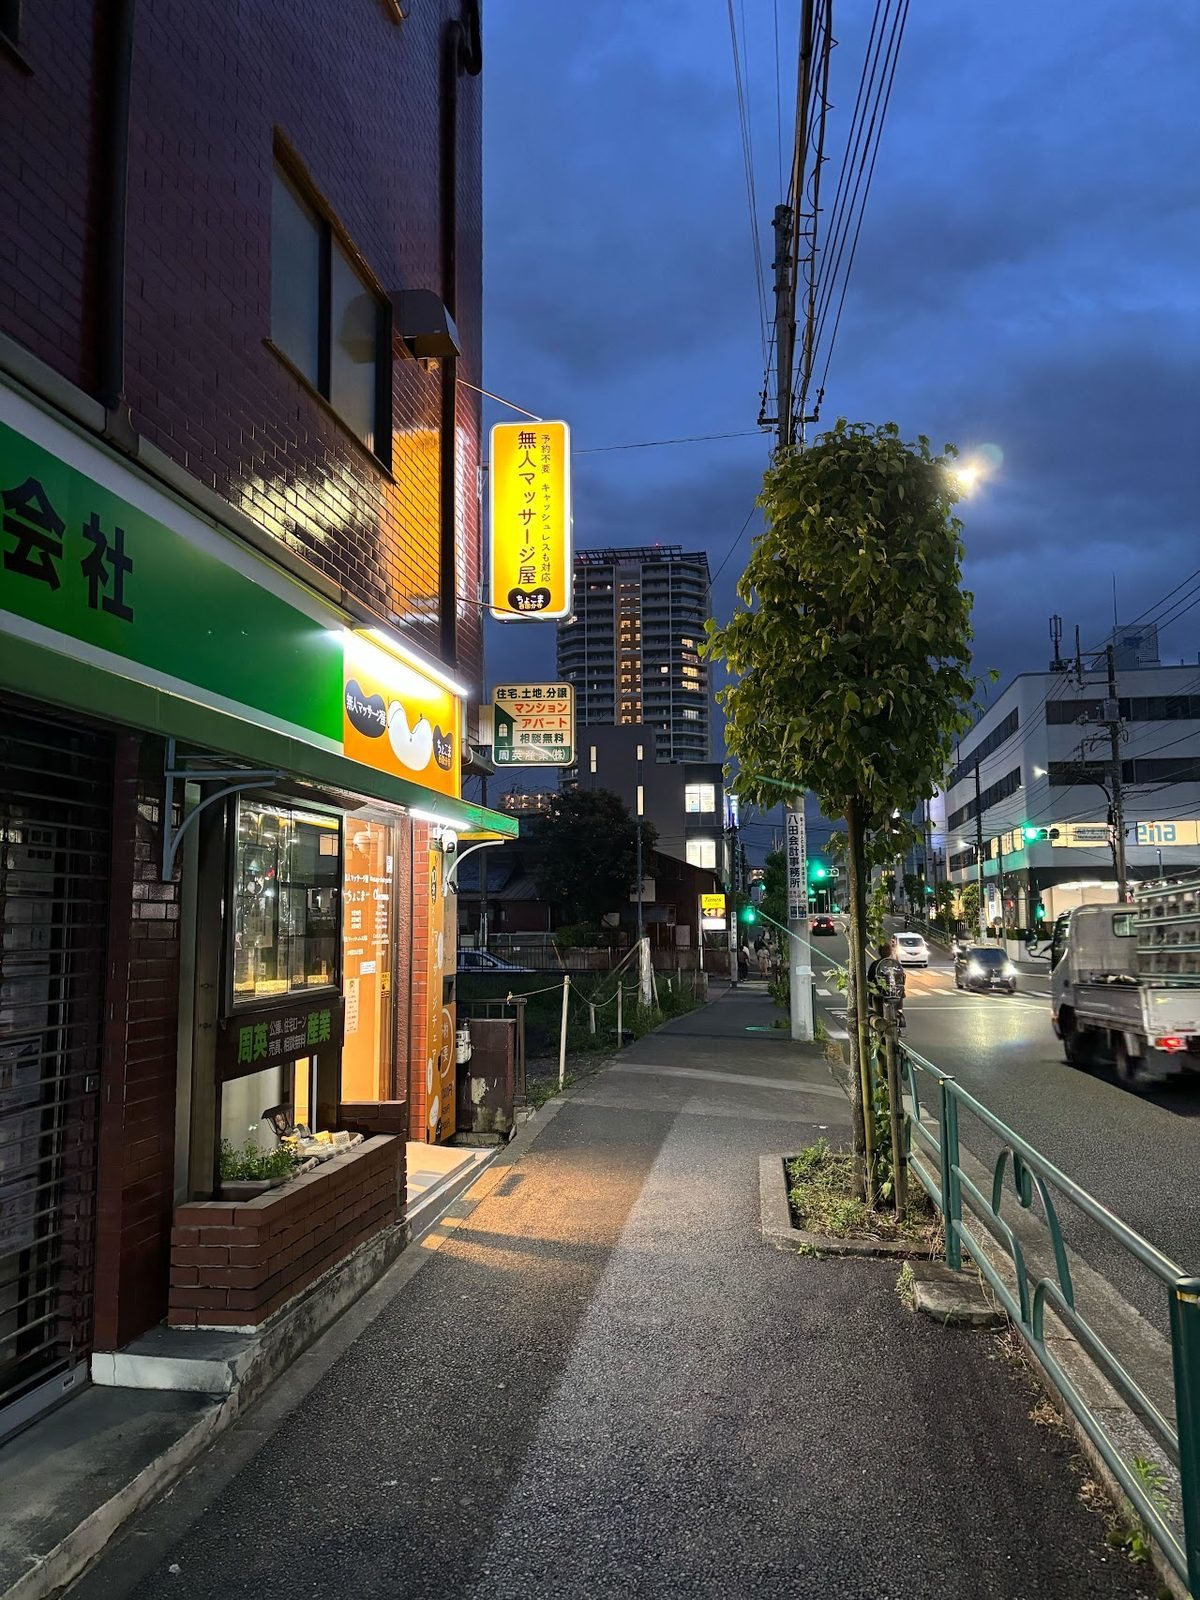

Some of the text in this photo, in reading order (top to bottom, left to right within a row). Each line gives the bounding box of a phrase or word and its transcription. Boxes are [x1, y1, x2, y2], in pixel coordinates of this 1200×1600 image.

[517, 430, 537, 585] 無人マッサージ屋
[541, 434, 551, 582] 予約不要 キャッシュレスも対応
[1, 477, 133, 623] 会社
[516, 594, 545, 604] ちょこま
[346, 692, 386, 727] 無人マッサージ屋
[514, 703, 567, 714] マンション
[522, 717, 567, 728] アパート
[520, 733, 564, 744] 相談無料
[788, 814, 801, 888] 八田会計事務所
[307, 1008, 331, 1045] 産業
